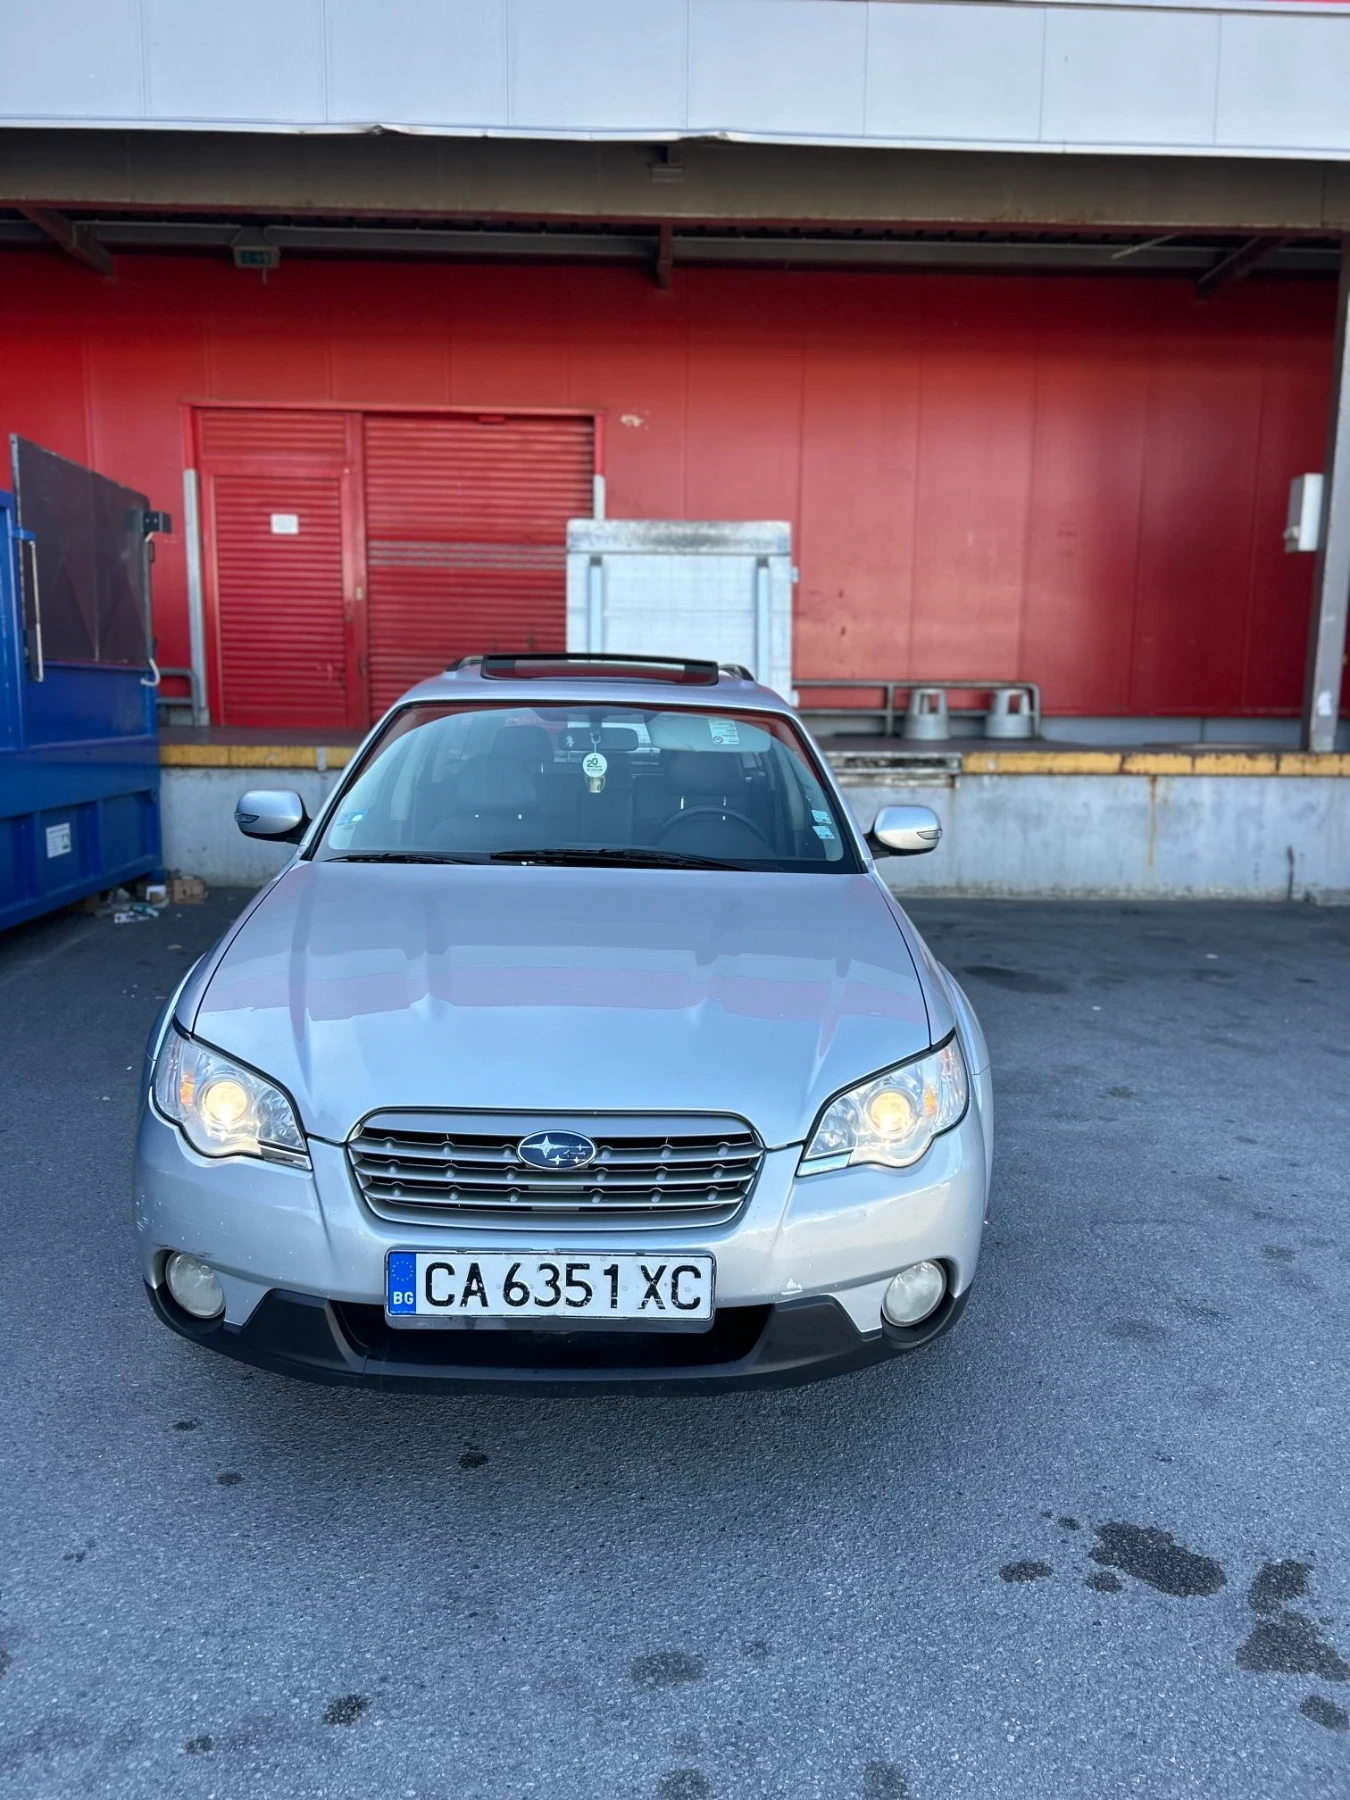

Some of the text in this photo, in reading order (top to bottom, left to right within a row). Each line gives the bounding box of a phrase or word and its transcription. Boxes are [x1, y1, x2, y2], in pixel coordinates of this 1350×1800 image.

[393, 1291, 414, 1305] BG
[425, 1262, 702, 1311] CA 6351 XC
